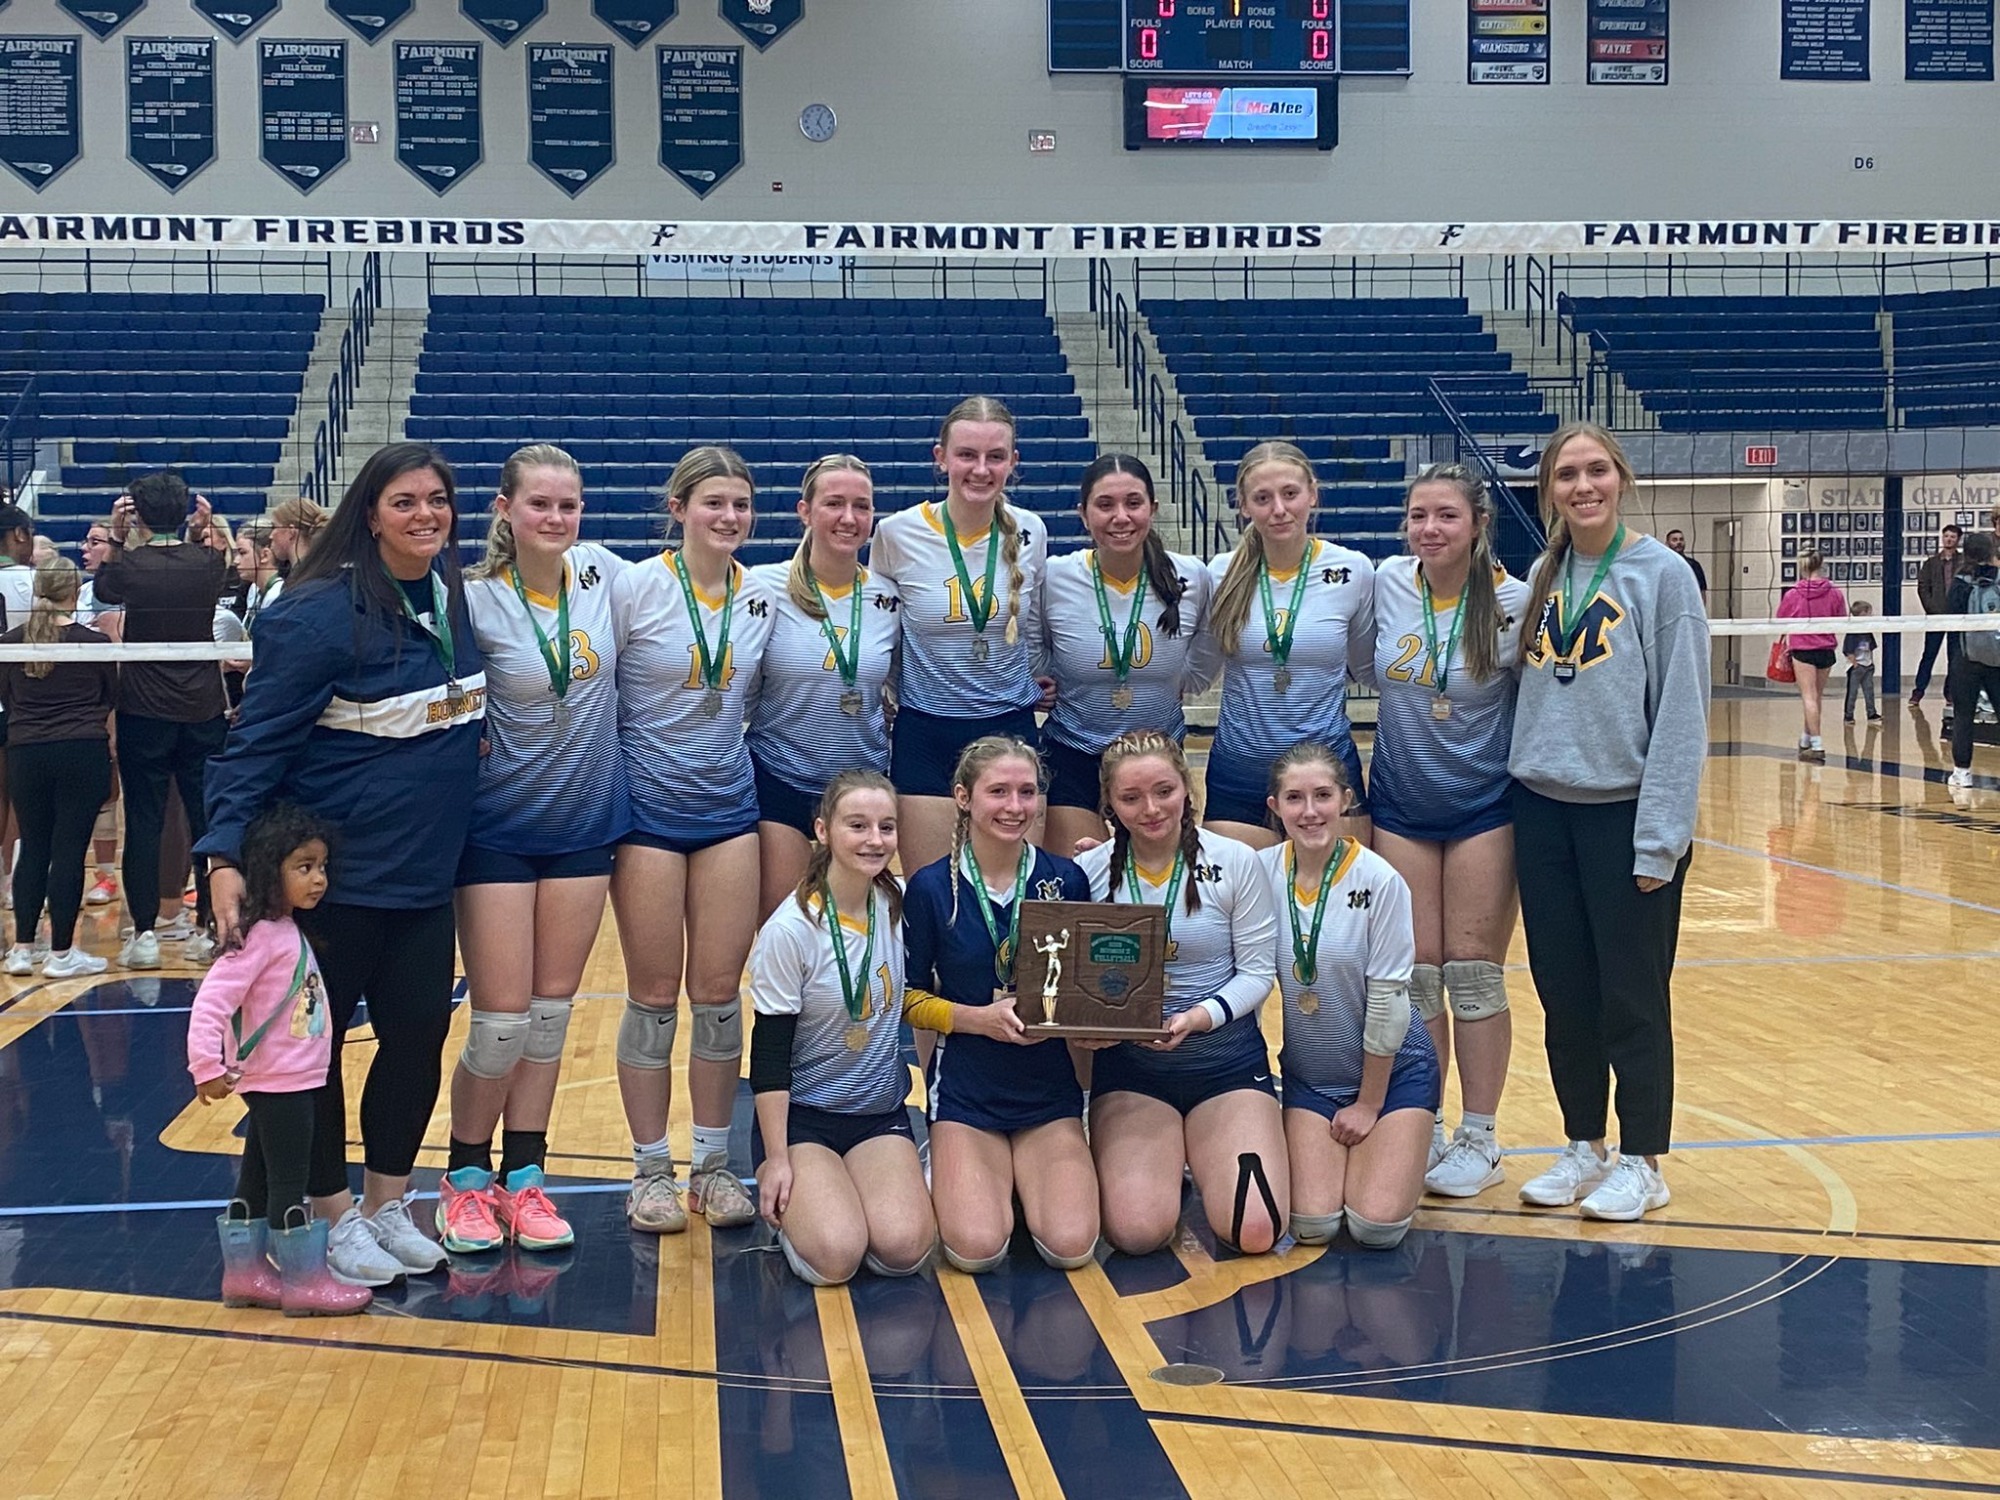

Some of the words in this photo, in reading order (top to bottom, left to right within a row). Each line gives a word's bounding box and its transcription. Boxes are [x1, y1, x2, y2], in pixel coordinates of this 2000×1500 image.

[1187, 6, 1215, 16] BONUS
[1248, 7, 1276, 16] BONUS
[1131, 19, 1161, 28] FOULS
[1205, 19, 1243, 29] PLAYER
[1249, 20, 1274, 29] FOUL
[1302, 21, 1332, 29] FOULS
[131, 42, 209, 56] FAIRMONT
[1141, 29, 1157, 58] 0
[1312, 31, 1328, 59] 0
[1480, 43, 1530, 53] MIAMISBURG
[1600, 44, 1632, 54] WAYNE
[264, 44, 341, 58] FAIRMONT
[400, 46, 476, 60] FAIRMONT
[533, 49, 608, 63] FAIRMONT
[663, 51, 737, 64] FAIRMONT
[1129, 59, 1163, 69] SCORE
[1219, 60, 1253, 69] MATCH
[1300, 61, 1333, 70] SCORE
[1246, 102, 1303, 114] McAfee
[1855, 157, 1873, 169] D6
[254, 218, 525, 245] FIREBIRDS
[803, 225, 1053, 249] FAIRMONT
[1074, 226, 1321, 250] FIREBIRDS
[1584, 222, 1819, 246] FAIRMONT
[1751, 449, 1772, 463] EXIT
[1386, 633, 1446, 688] 21
